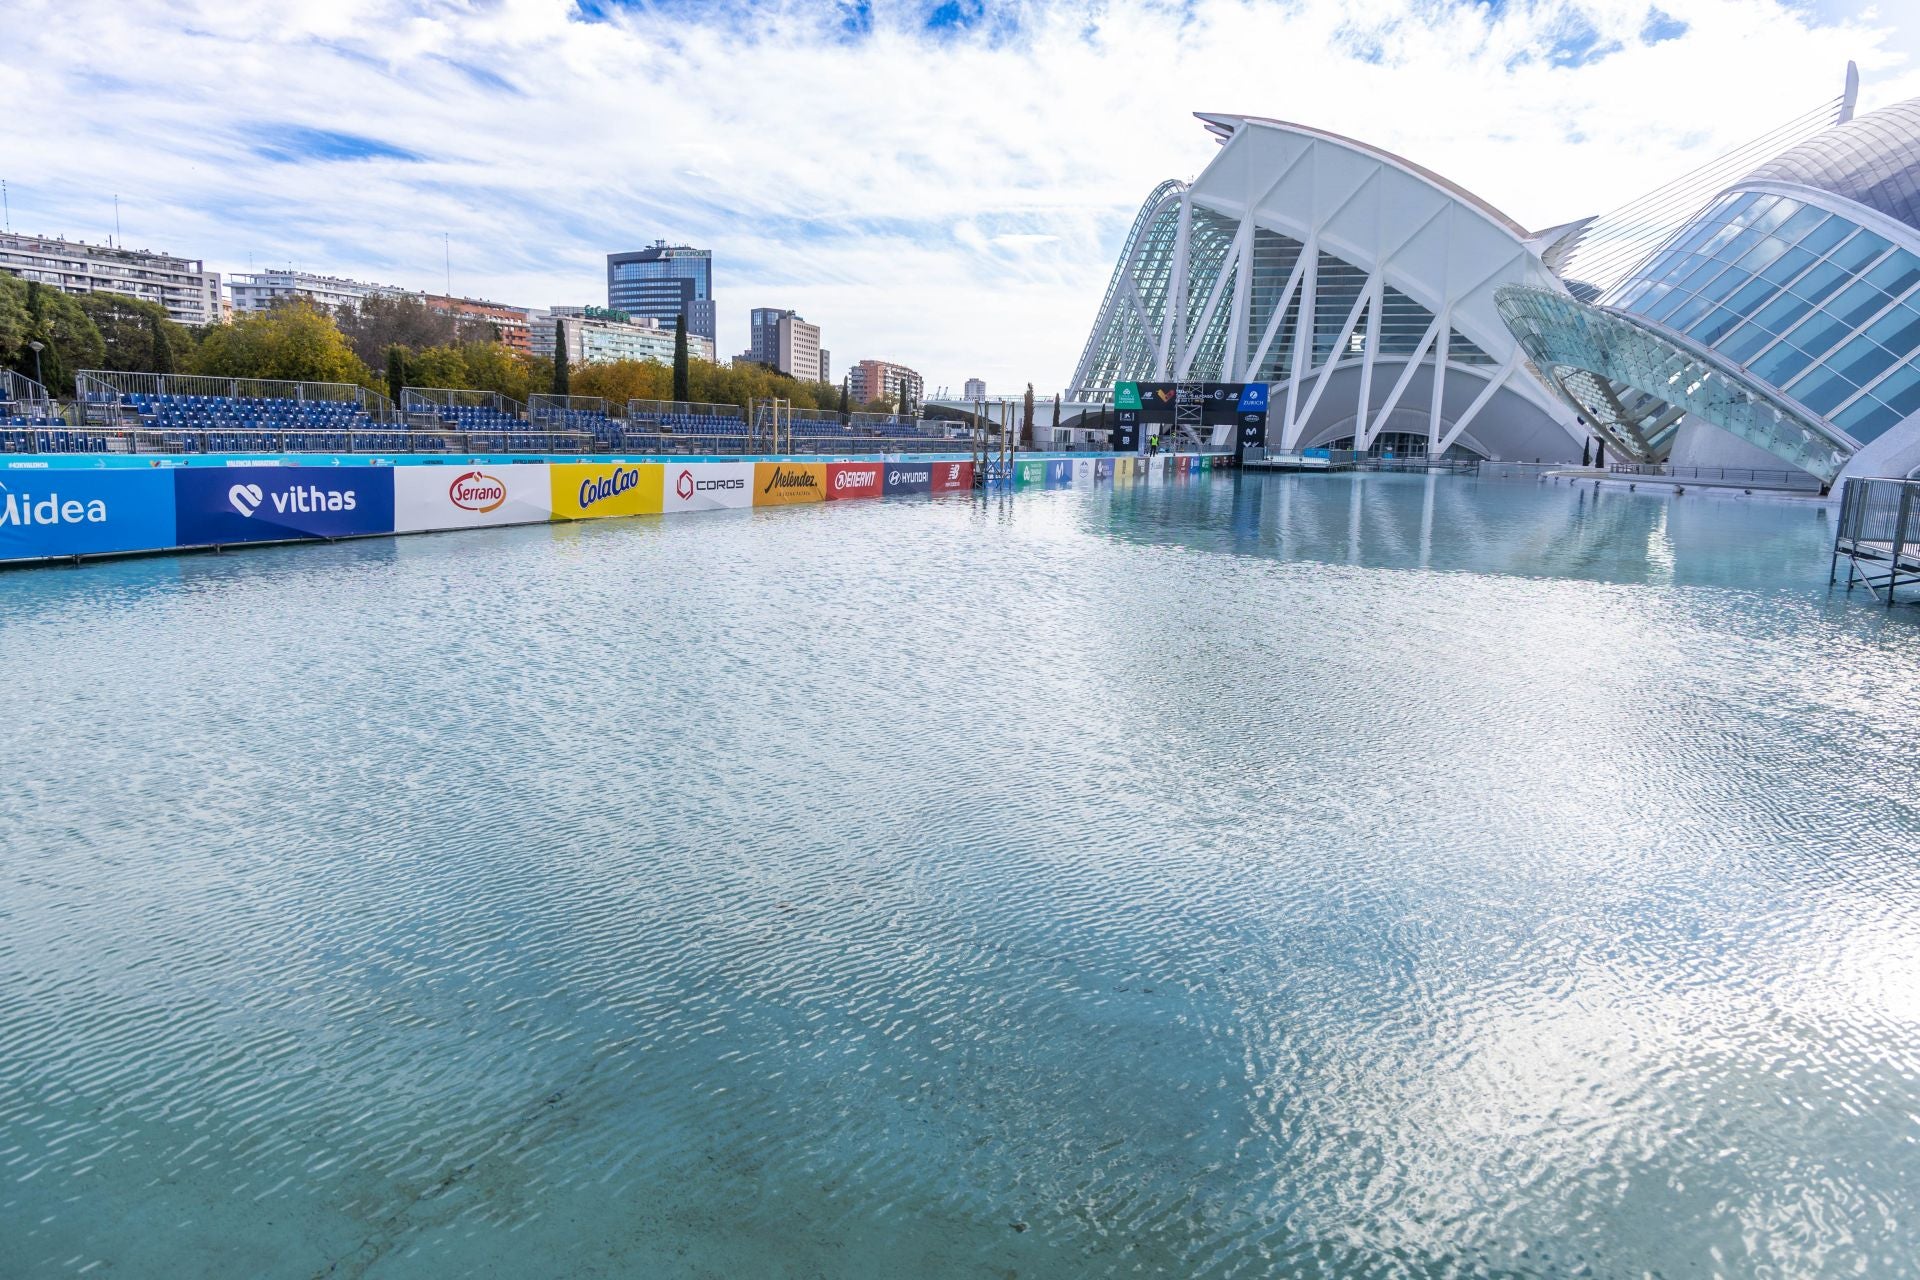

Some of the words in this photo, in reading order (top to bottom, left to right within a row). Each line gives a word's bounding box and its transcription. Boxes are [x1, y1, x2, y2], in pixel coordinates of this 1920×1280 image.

[696, 479, 744, 491] COROS
[846, 471, 876, 488] ENERVIT
[902, 472, 929, 483] HYUNDAI
[454, 482, 502, 501] Serrano
[579, 467, 639, 509] ColaCao
[271, 485, 356, 513] vithas
